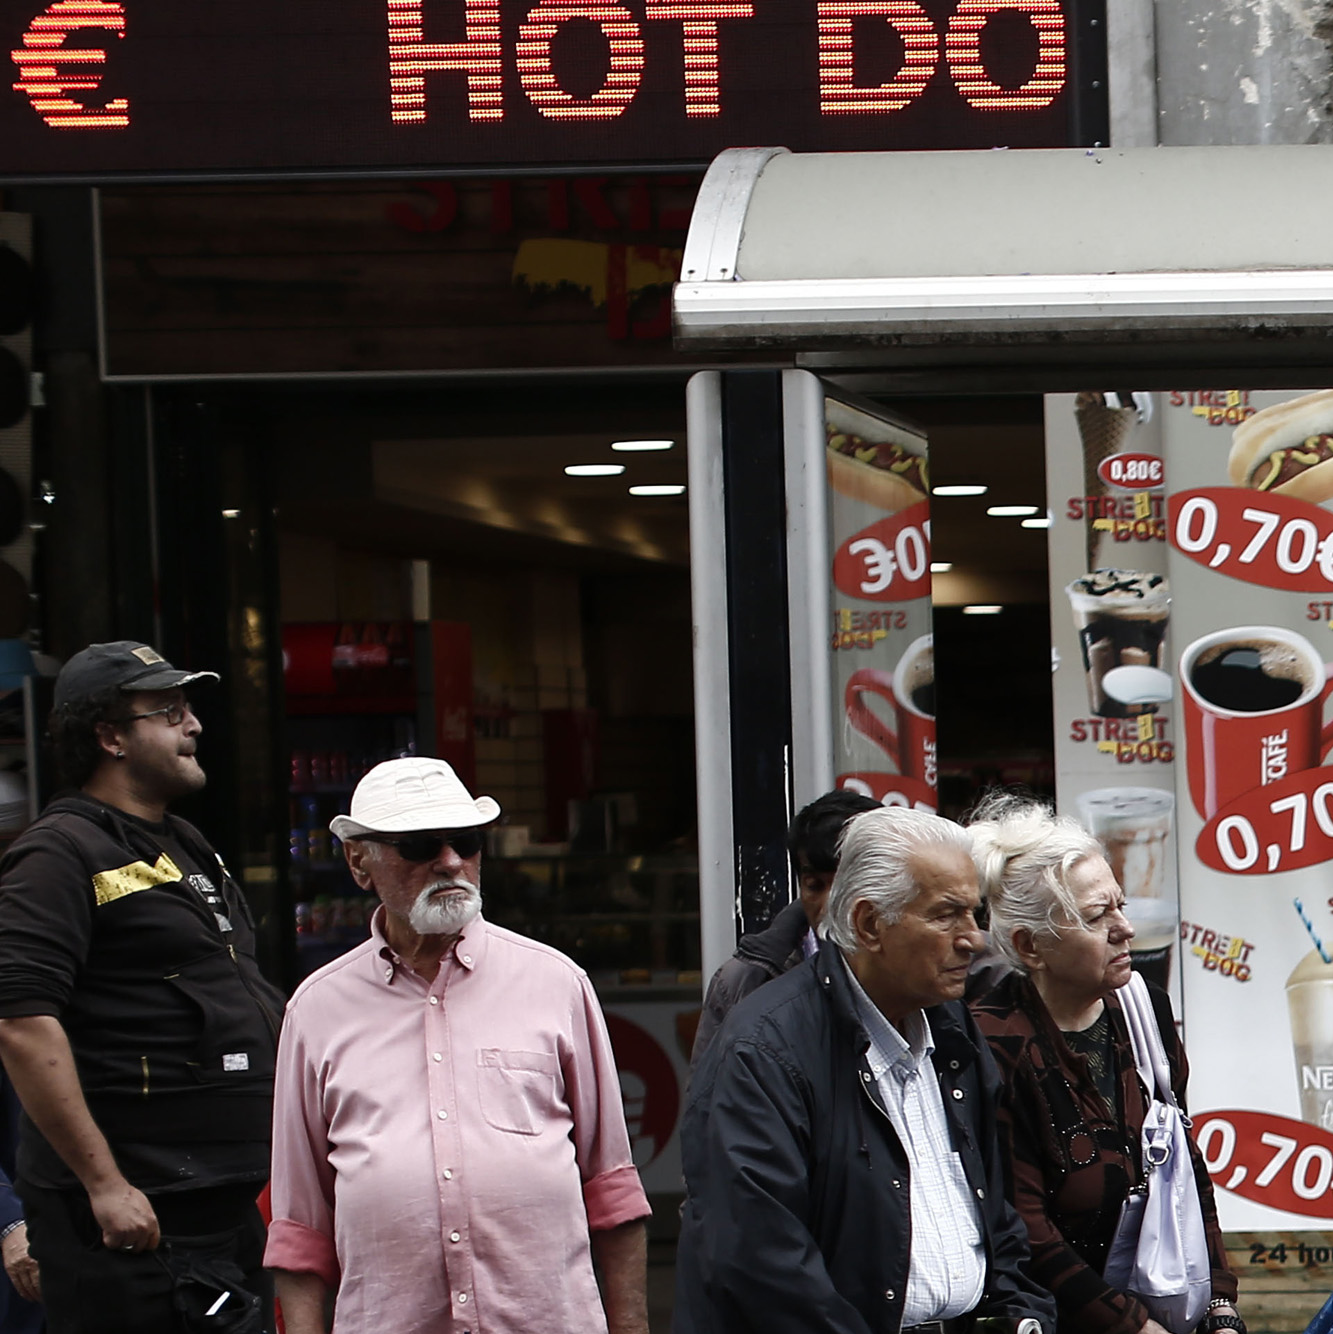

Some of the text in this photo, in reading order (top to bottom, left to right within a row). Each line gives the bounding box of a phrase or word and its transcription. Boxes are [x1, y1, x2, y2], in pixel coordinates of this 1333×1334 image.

[388, 0, 755, 124] HOT
[1110, 459, 1163, 483] 0,80€
[1250, 1242, 1288, 1264] 24
